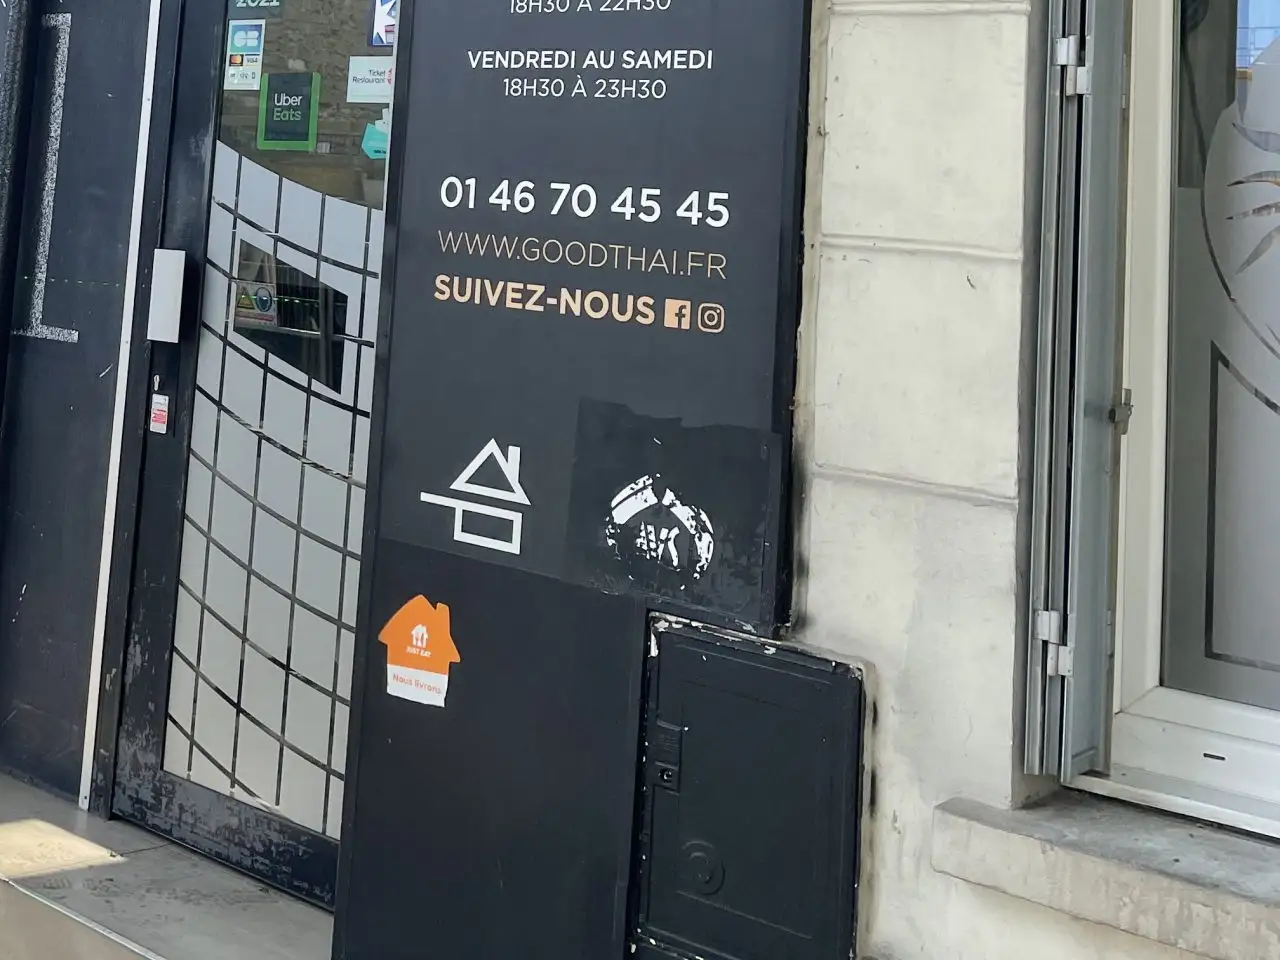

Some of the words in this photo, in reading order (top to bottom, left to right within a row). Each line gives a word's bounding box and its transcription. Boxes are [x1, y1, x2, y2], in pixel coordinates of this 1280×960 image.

[467, 50, 576, 69] VENDREDI
[582, 50, 615, 69] AU
[621, 49, 713, 69] SAMEDI
[368, 69, 386, 77] Ticket
[503, 78, 565, 97] 18H30
[571, 74, 587, 98] À
[593, 79, 668, 99] 23H30
[273, 92, 303, 107] Uber
[273, 107, 303, 122] Eats
[440, 176, 477, 209] 01
[488, 179, 536, 213] 46
[549, 182, 597, 218] 70
[610, 186, 662, 223] 45
[675, 190, 730, 227] 45
[437, 230, 727, 280] WWW.GOODTHAI.FR
[433, 274, 656, 325] SUIVEZ-NOUS
[392, 673, 413, 687] Nous
[414, 678, 442, 695] livrons
